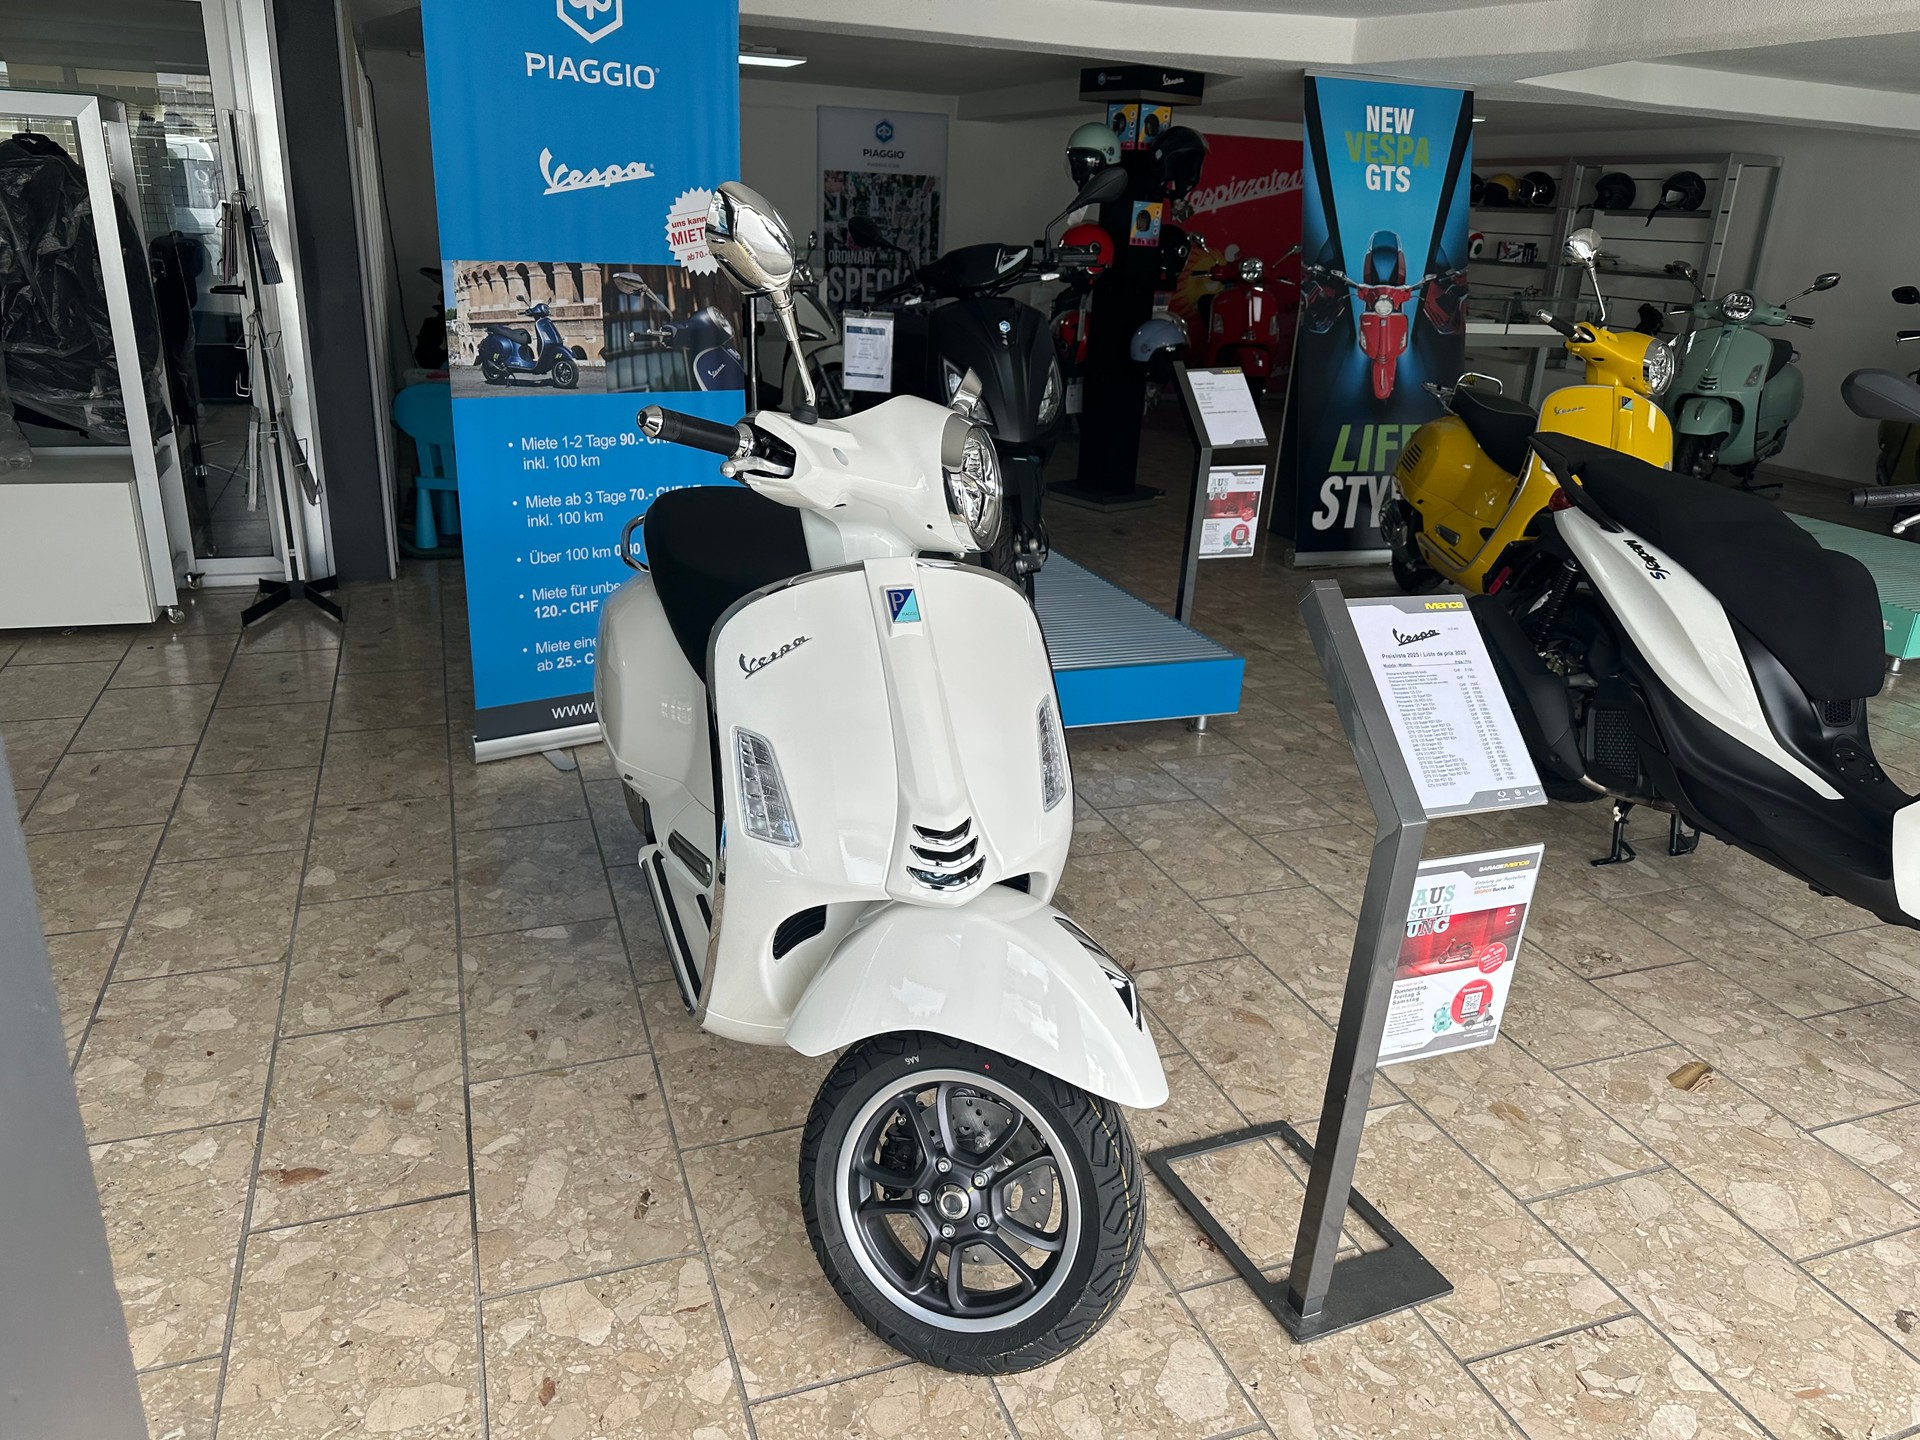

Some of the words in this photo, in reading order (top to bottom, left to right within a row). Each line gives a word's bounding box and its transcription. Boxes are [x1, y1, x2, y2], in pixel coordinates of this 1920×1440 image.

[524, 52, 656, 90] PIAGGIO
[1162, 74, 1184, 86] Vespa
[1366, 105, 1414, 135] NEW
[863, 148, 904, 160] PIAGGIO
[1345, 131, 1430, 168] VESPA
[539, 146, 655, 196] Vespa
[1365, 164, 1411, 192] GTS
[828, 250, 876, 265] ORDINARY
[522, 437, 558, 451] Miete
[562, 436, 582, 448] 1-2
[585, 434, 616, 450] Tage
[620, 434, 644, 446] 90.-
[524, 456, 549, 470] inkl.
[554, 454, 578, 468] 100
[581, 454, 600, 466] km
[526, 494, 562, 509] Miete
[566, 492, 582, 506] ab
[584, 492, 593, 504] 3
[596, 490, 626, 506] Tage
[630, 488, 653, 502] 70.-
[528, 514, 553, 528] inkl.
[558, 512, 581, 525] 100
[584, 510, 604, 522] km
[530, 550, 562, 565] Über
[566, 548, 589, 561] 100
[592, 546, 611, 559] km
[1624, 540, 1671, 575] Medley
[532, 588, 568, 602] Miete
[570, 584, 588, 597] für
[890, 592, 904, 612] P
[534, 604, 567, 619] 120.-
[570, 600, 599, 615] CHF
[1392, 628, 1440, 646] Vespa
[536, 641, 570, 654] Miete
[537, 659, 554, 672] ab
[556, 656, 582, 670] 25.-
[739, 636, 812, 680] Vespa
[1412, 884, 1456, 908] AUS
[1410, 904, 1452, 920] STELL
[1406, 916, 1450, 938] UNG
